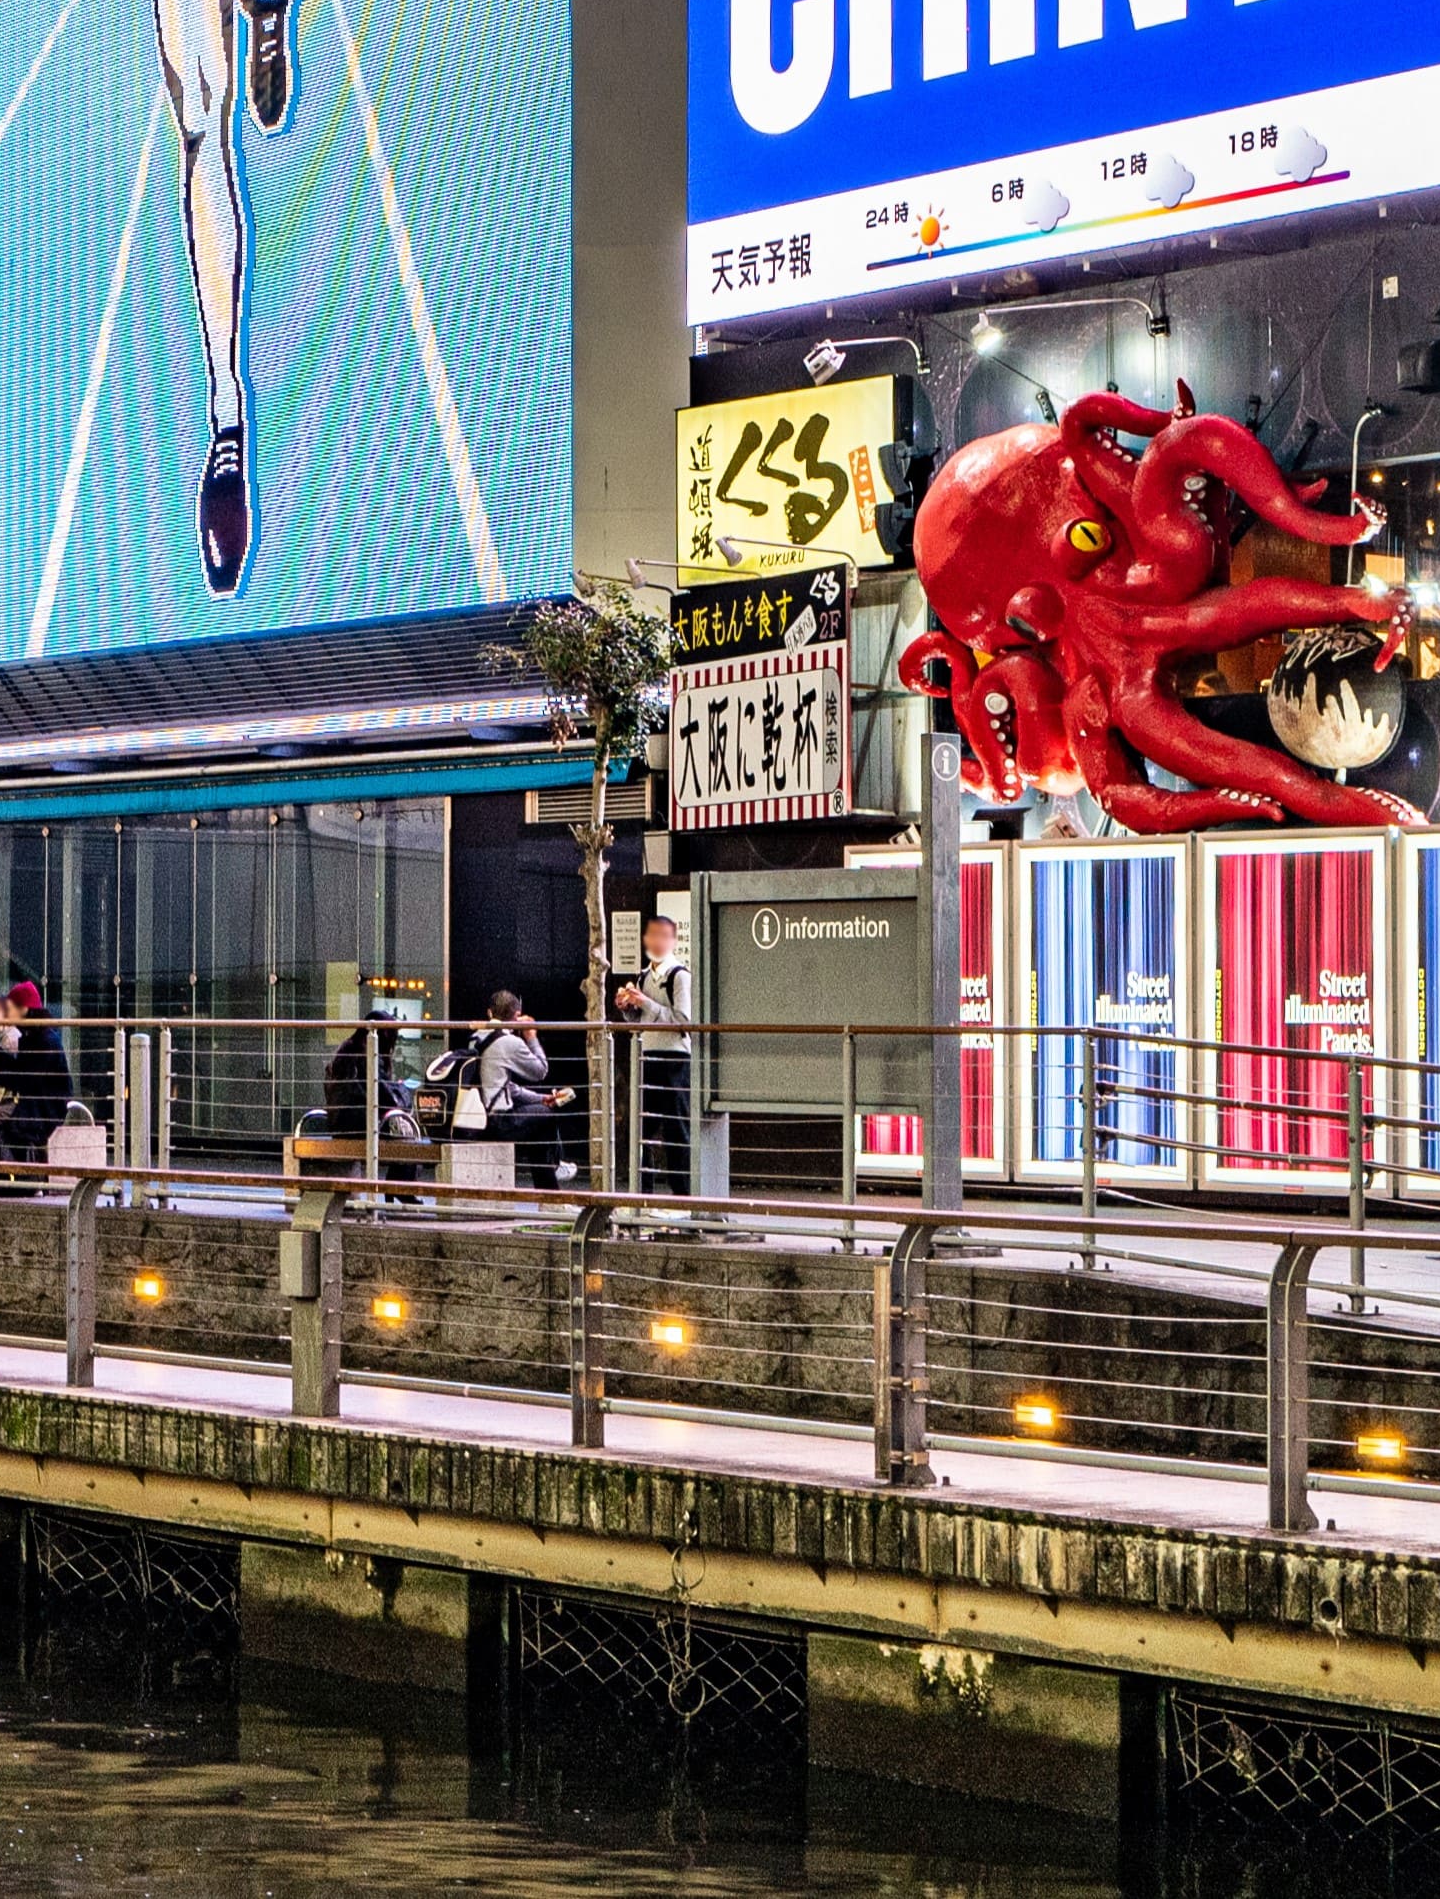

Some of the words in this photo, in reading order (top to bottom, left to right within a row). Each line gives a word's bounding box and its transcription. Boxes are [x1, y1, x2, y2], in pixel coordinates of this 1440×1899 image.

[864, 200, 911, 231] 24時
[990, 176, 1026, 205] 6時
[1099, 151, 1149, 182] 12時
[1226, 123, 1280, 157] 18時
[709, 230, 814, 295] 天気予報
[759, 548, 806, 569] KUKURU
[819, 609, 842, 641] 2F
[678, 678, 819, 800] 大阪に乾杯
[824, 690, 839, 766] 検索
[784, 915, 891, 940] information
[1126, 970, 1170, 999] Street
[1319, 968, 1367, 997] Street
